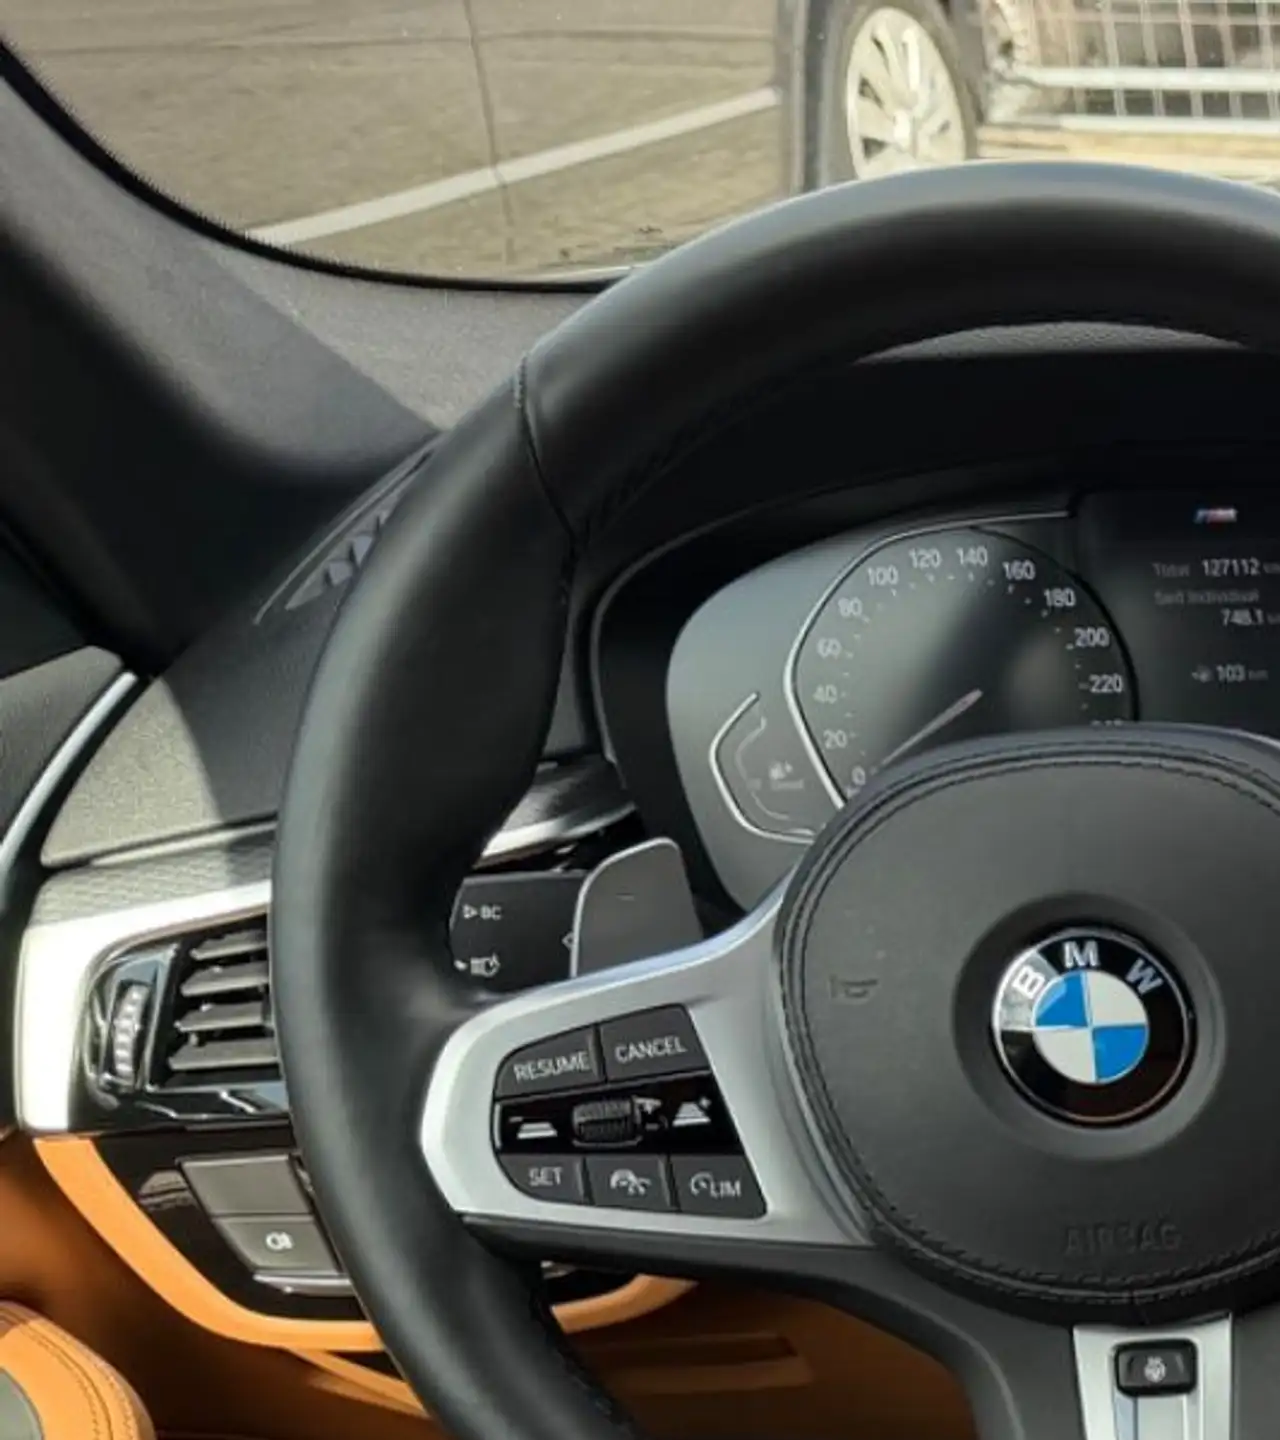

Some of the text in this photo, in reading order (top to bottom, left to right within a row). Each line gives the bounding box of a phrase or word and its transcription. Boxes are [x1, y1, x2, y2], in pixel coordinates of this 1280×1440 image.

[908, 549, 941, 569] 120
[956, 546, 988, 567] 140
[867, 565, 899, 586] 100
[1003, 559, 1036, 581] 160
[1202, 558, 1261, 577] 127112
[839, 598, 863, 617] 80
[1044, 588, 1076, 608] 180
[1074, 628, 1110, 648] 200
[817, 639, 841, 658] 60
[1217, 664, 1245, 682] 103
[813, 685, 838, 703] 40
[1089, 674, 1123, 694] 220
[823, 730, 847, 748] 20
[852, 768, 866, 786] 0
[480, 904, 502, 920] BC
[1012, 940, 1164, 1000] BMW
[614, 1035, 688, 1064] CANCEL
[513, 1052, 590, 1082] RESUME
[528, 1167, 563, 1187] SET
[710, 1180, 742, 1198] LIM
[1065, 1217, 1182, 1255] AIRBAG
